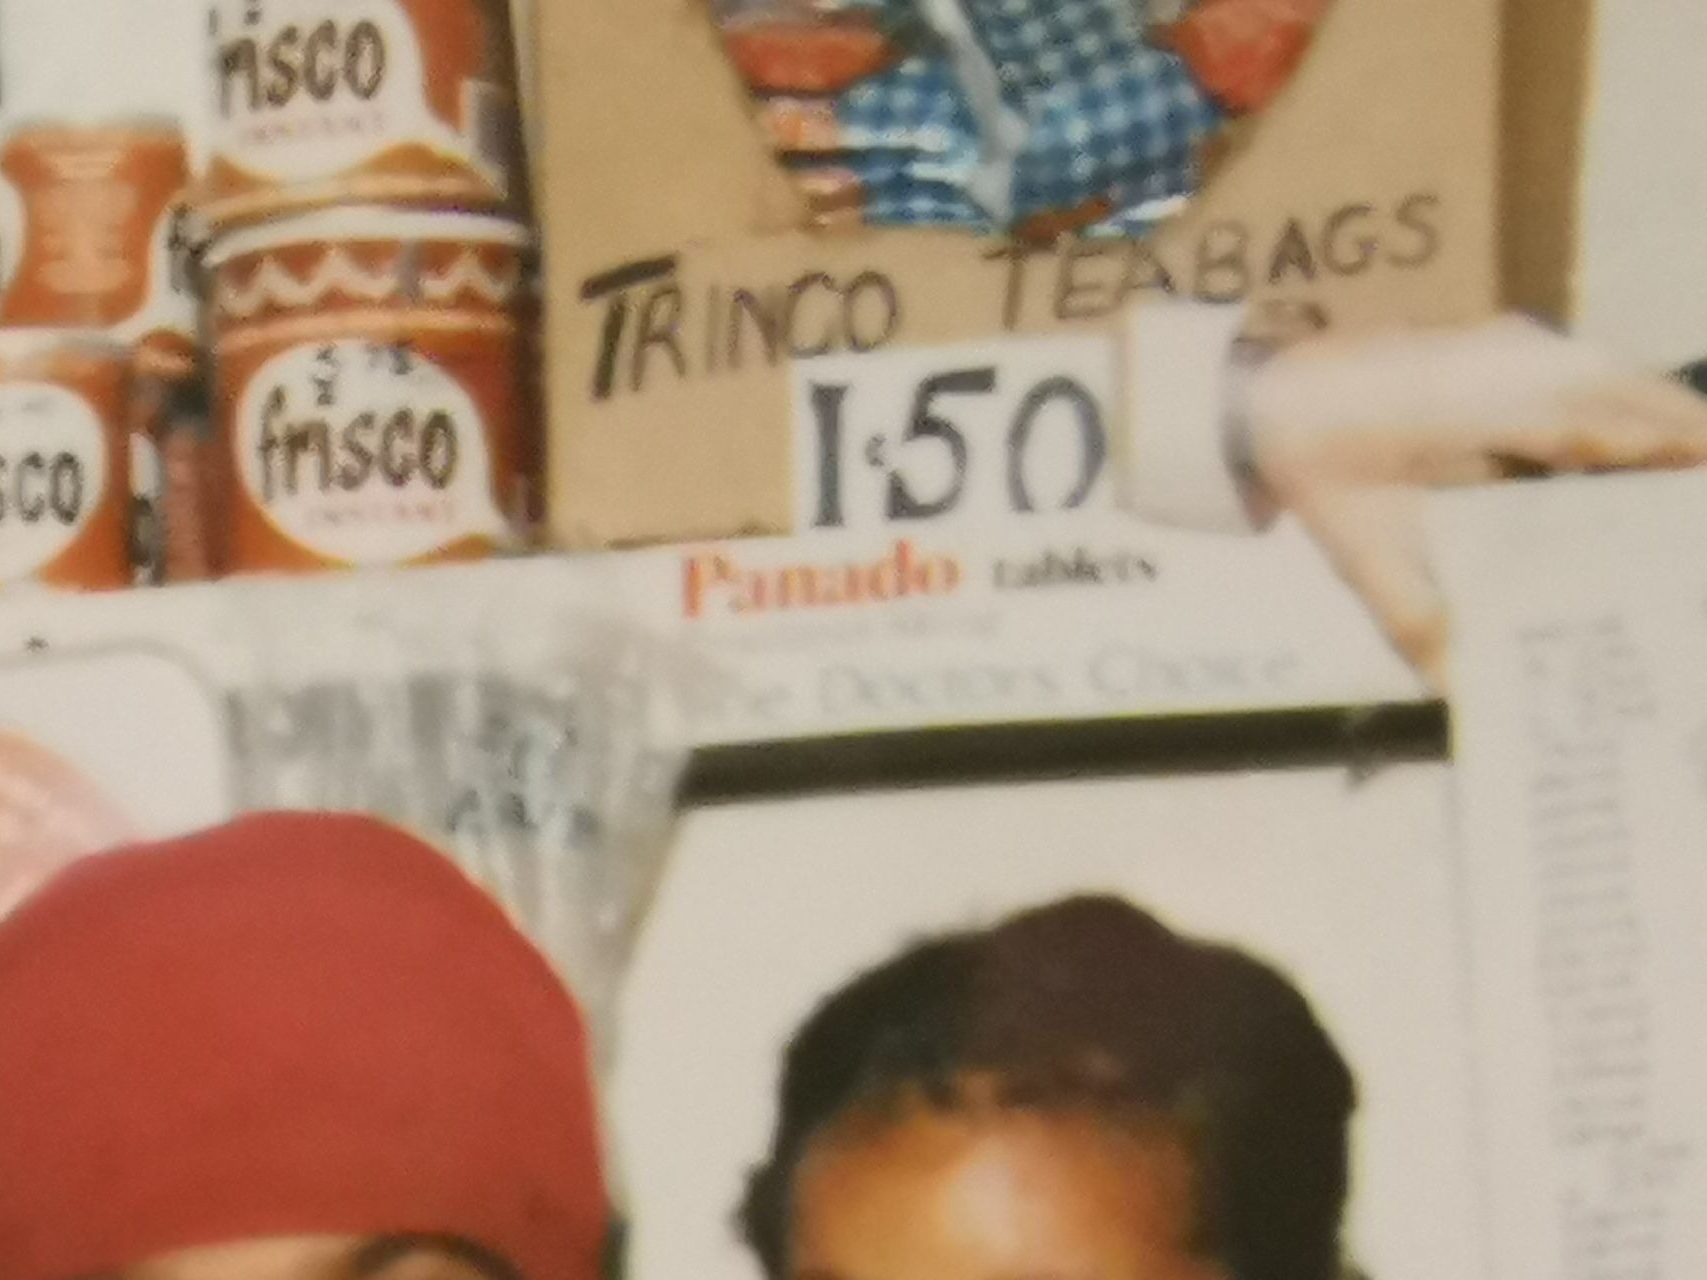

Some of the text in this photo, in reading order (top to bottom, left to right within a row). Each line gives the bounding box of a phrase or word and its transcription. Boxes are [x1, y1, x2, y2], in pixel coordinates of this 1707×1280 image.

[580, 194, 1445, 402] TRINCO TEABAGS
[255, 383, 459, 503] frisco
[681, 538, 961, 620] Panado
